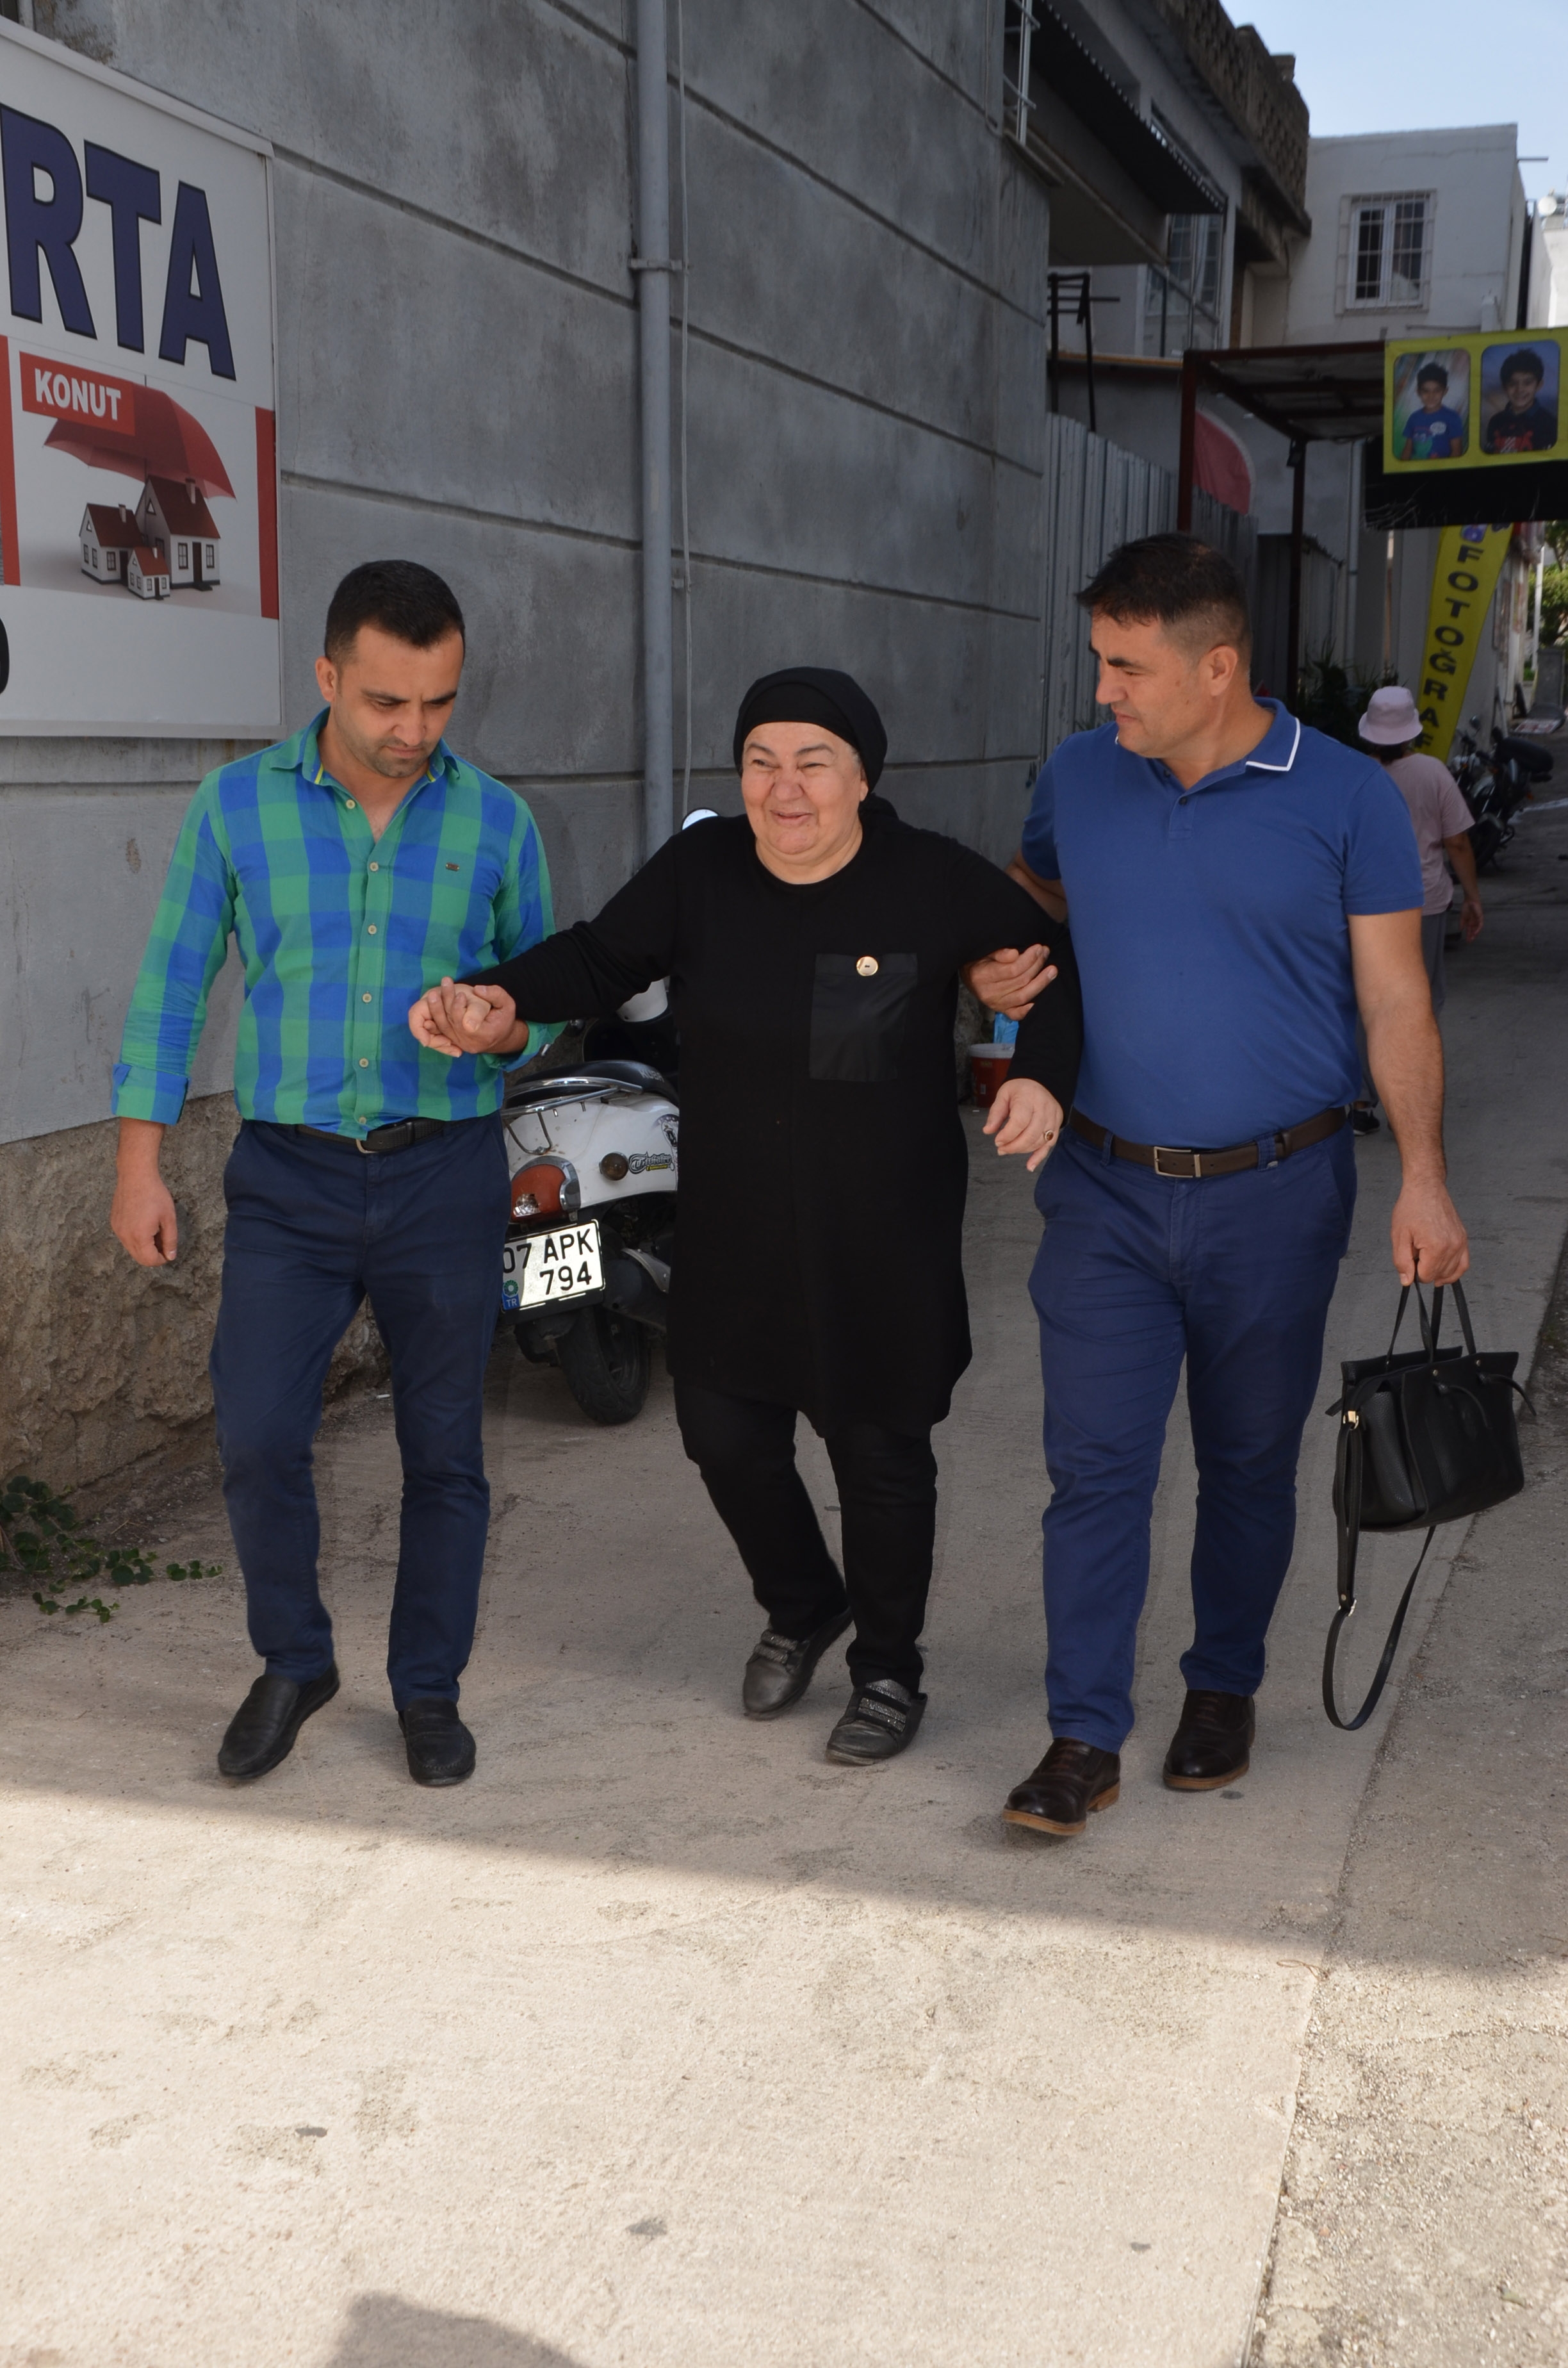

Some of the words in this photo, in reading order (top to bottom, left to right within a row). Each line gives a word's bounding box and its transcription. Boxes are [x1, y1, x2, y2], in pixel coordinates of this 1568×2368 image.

[0, 103, 236, 381] RTA
[35, 370, 122, 421] KONUT
[503, 1243, 532, 1274] 07
[544, 1228, 594, 1264] APK
[539, 1261, 592, 1295] 794
[506, 1299, 518, 1308] TR
